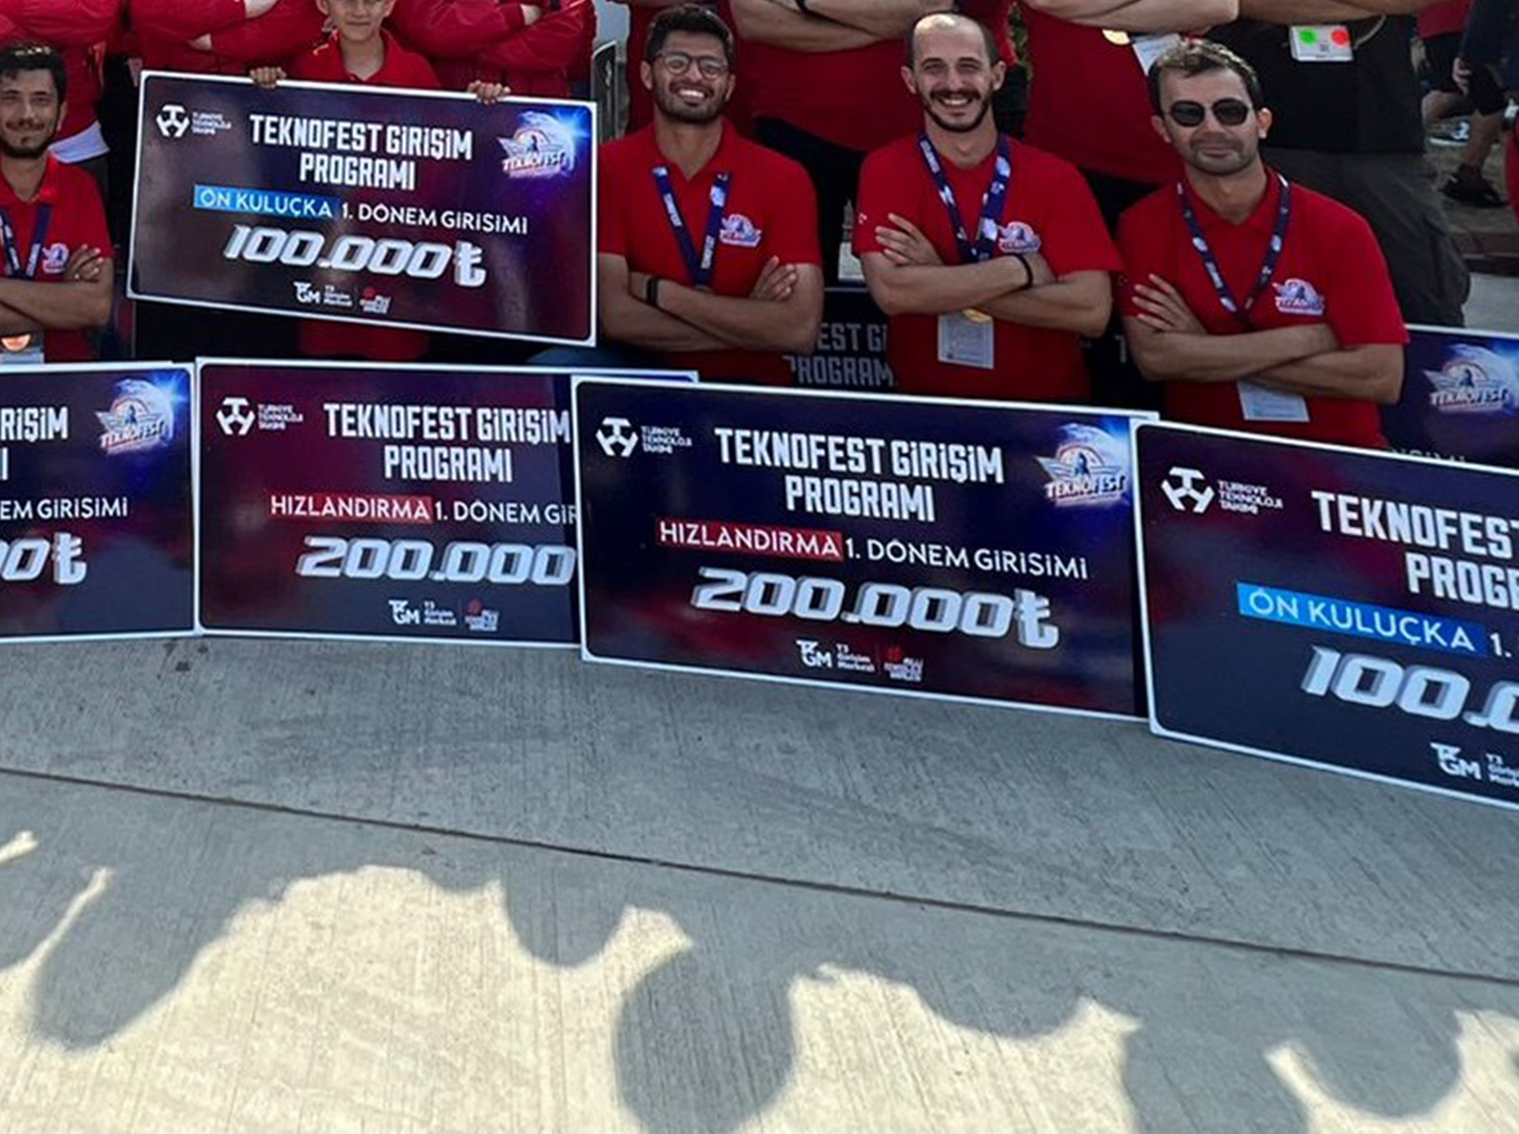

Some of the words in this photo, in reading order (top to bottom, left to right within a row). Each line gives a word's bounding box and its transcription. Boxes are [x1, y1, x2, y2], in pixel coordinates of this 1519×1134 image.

[250, 115, 382, 152] TEKNOFEST
[300, 153, 415, 190] PROGRAMI
[237, 194, 332, 218] KULUÇKA
[341, 202, 353, 219] 1.
[782, 353, 898, 387] ROGRAM
[324, 403, 471, 441] TEKNOFEST
[385, 445, 513, 482] PROGRAMI
[715, 427, 885, 476] TEKNOFEST
[271, 495, 429, 520] HIZLANDIRMA
[435, 502, 448, 521] 1.
[786, 475, 935, 523] PROGRAMI
[661, 521, 841, 559] HIZLANDIRMA
[846, 538, 861, 559] 1.
[296, 536, 577, 585] 200.000
[1308, 600, 1476, 652] KULUÇKA
[1490, 632, 1512, 658] 1.
